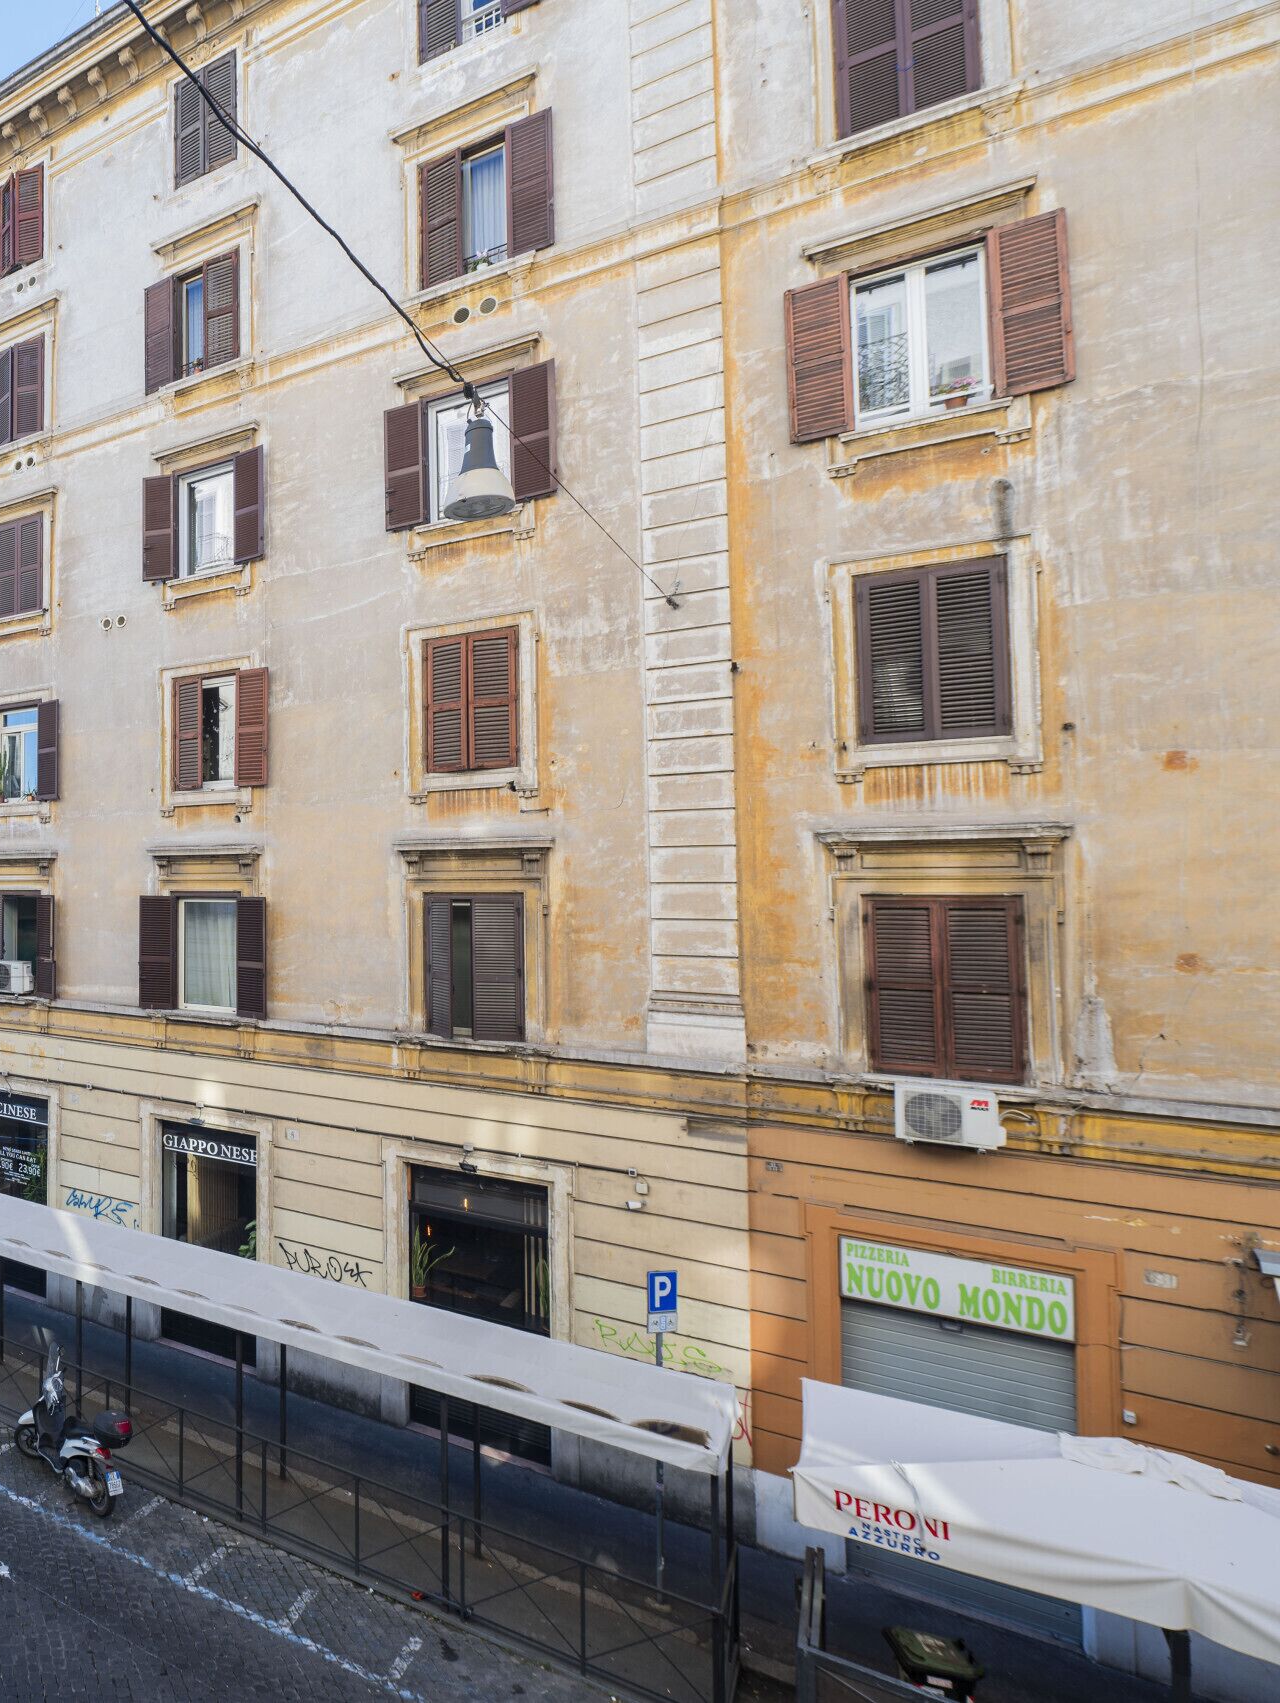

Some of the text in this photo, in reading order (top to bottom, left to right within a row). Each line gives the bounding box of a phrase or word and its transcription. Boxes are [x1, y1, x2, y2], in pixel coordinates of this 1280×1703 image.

[655, 1276, 671, 1307] P
[846, 1242, 1067, 1296] PIZZERIA BIRRERIA
[846, 1262, 1068, 1335] NUOVO MONDO
[834, 1490, 950, 1540] PERONI
[848, 1526, 941, 1561] AZZURRO
